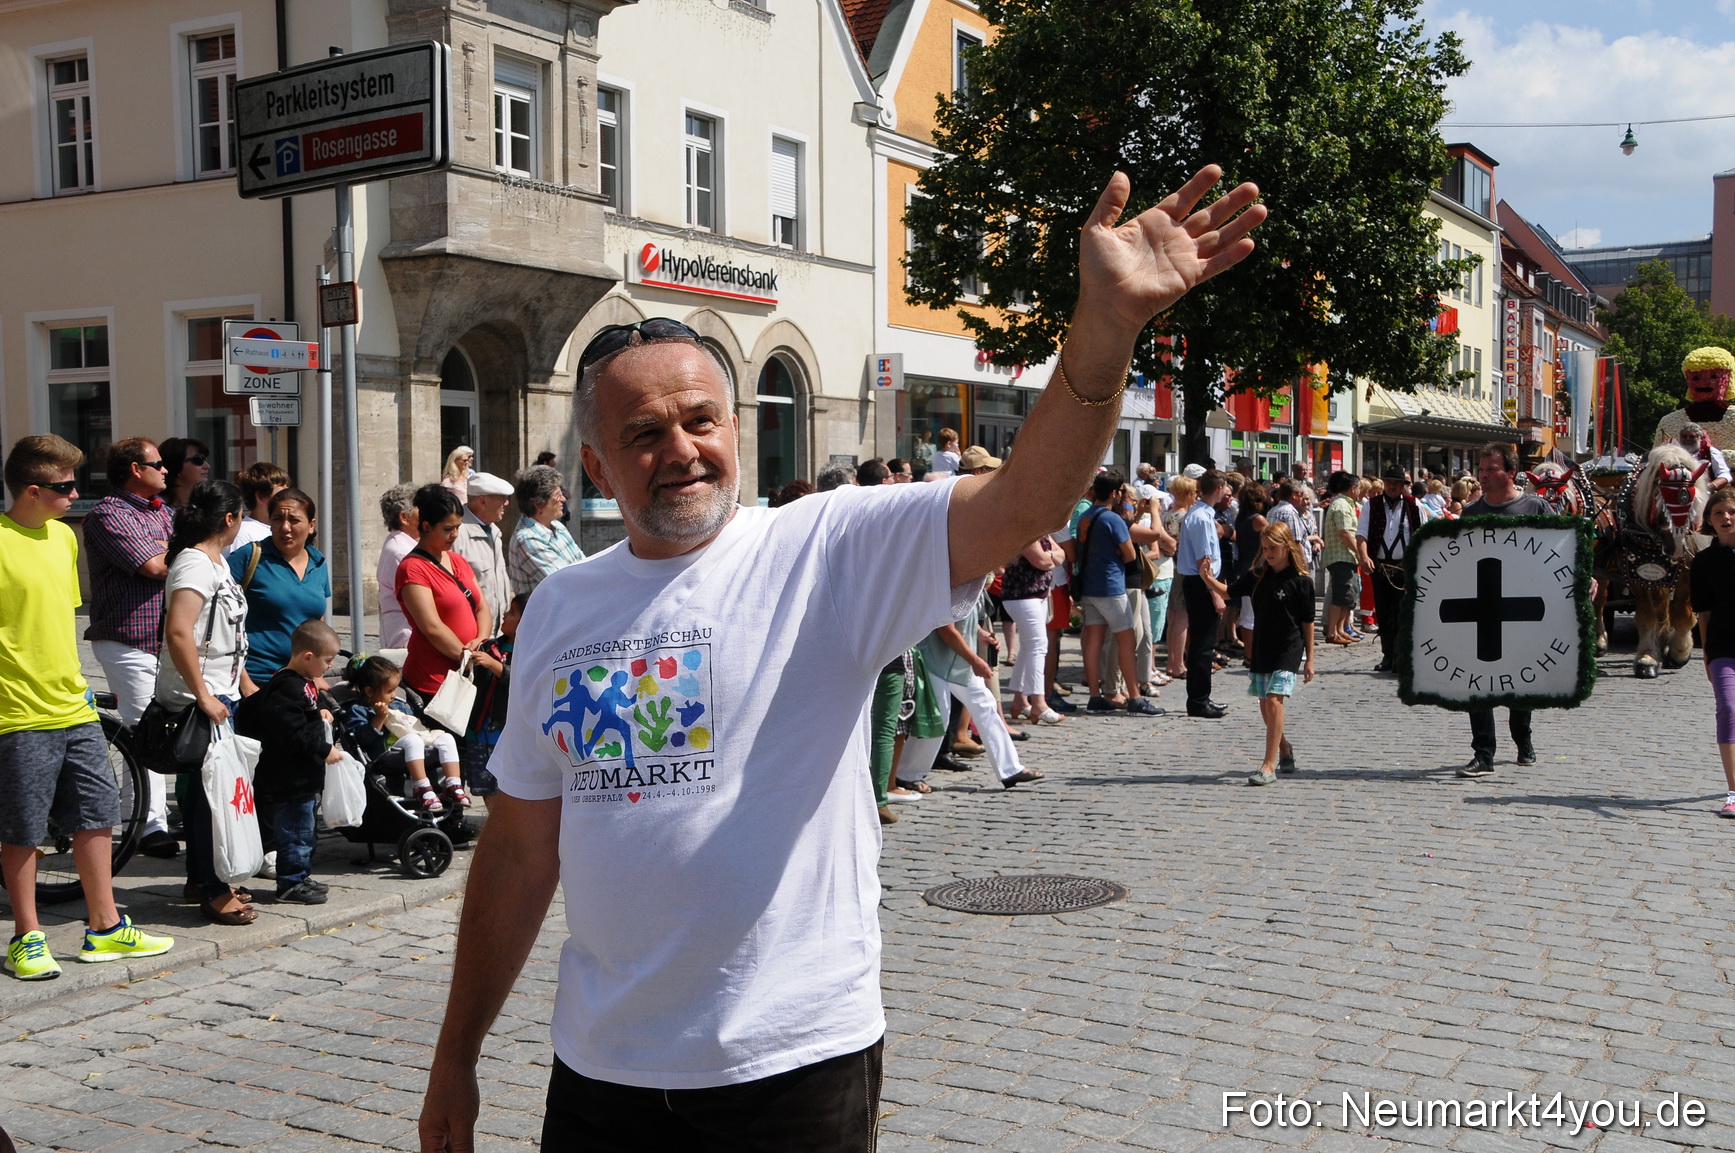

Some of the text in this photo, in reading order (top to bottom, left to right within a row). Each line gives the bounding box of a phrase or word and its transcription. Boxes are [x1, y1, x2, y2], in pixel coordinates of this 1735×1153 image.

[266, 72, 395, 119] Parkleitsystem
[312, 128, 397, 161] Rosengasse
[661, 248, 778, 291] HypoVereinsbank
[243, 377, 281, 389] ZONE
[1415, 528, 1575, 603] MINISTRANTEN
[552, 628, 712, 664] LANDESGARTENSCHAU
[1420, 638, 1570, 692] HOFKIRCHE
[570, 759, 714, 792] NEUMARKT
[642, 784, 716, 800] 24.4.-4.10.1998
